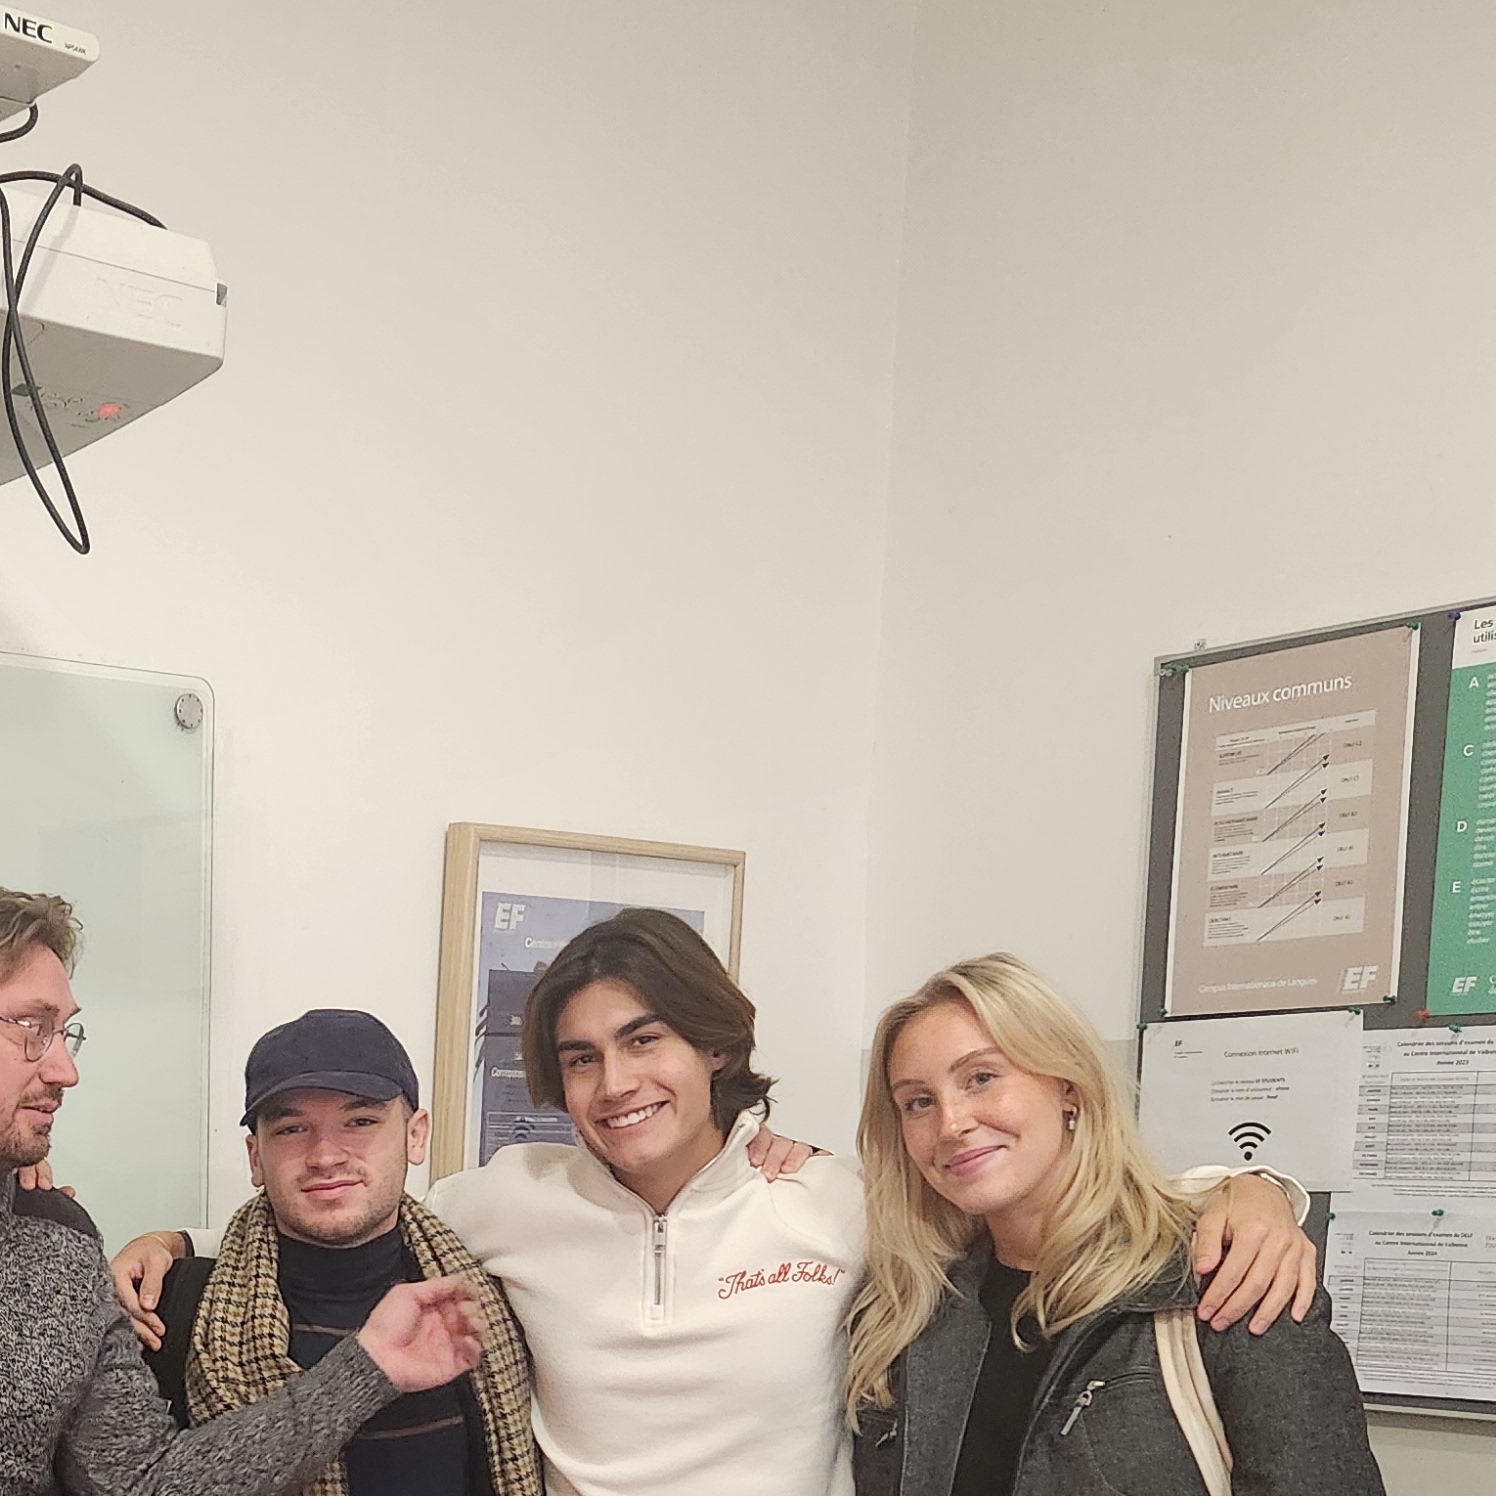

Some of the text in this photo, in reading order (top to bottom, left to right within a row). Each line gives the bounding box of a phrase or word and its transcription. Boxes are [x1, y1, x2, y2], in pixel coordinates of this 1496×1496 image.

[4, 12, 53, 44] NEC
[1474, 618, 1494, 630] Les
[1468, 676, 1479, 688] A
[1208, 675, 1353, 713] Niveaux communs
[1463, 744, 1474, 757] C
[1456, 820, 1467, 832] D
[1452, 881, 1461, 893] E
[494, 902, 526, 930] EF
[1342, 965, 1379, 991] EF
[1452, 976, 1477, 993] EF
[768, 1262, 792, 1285] all
